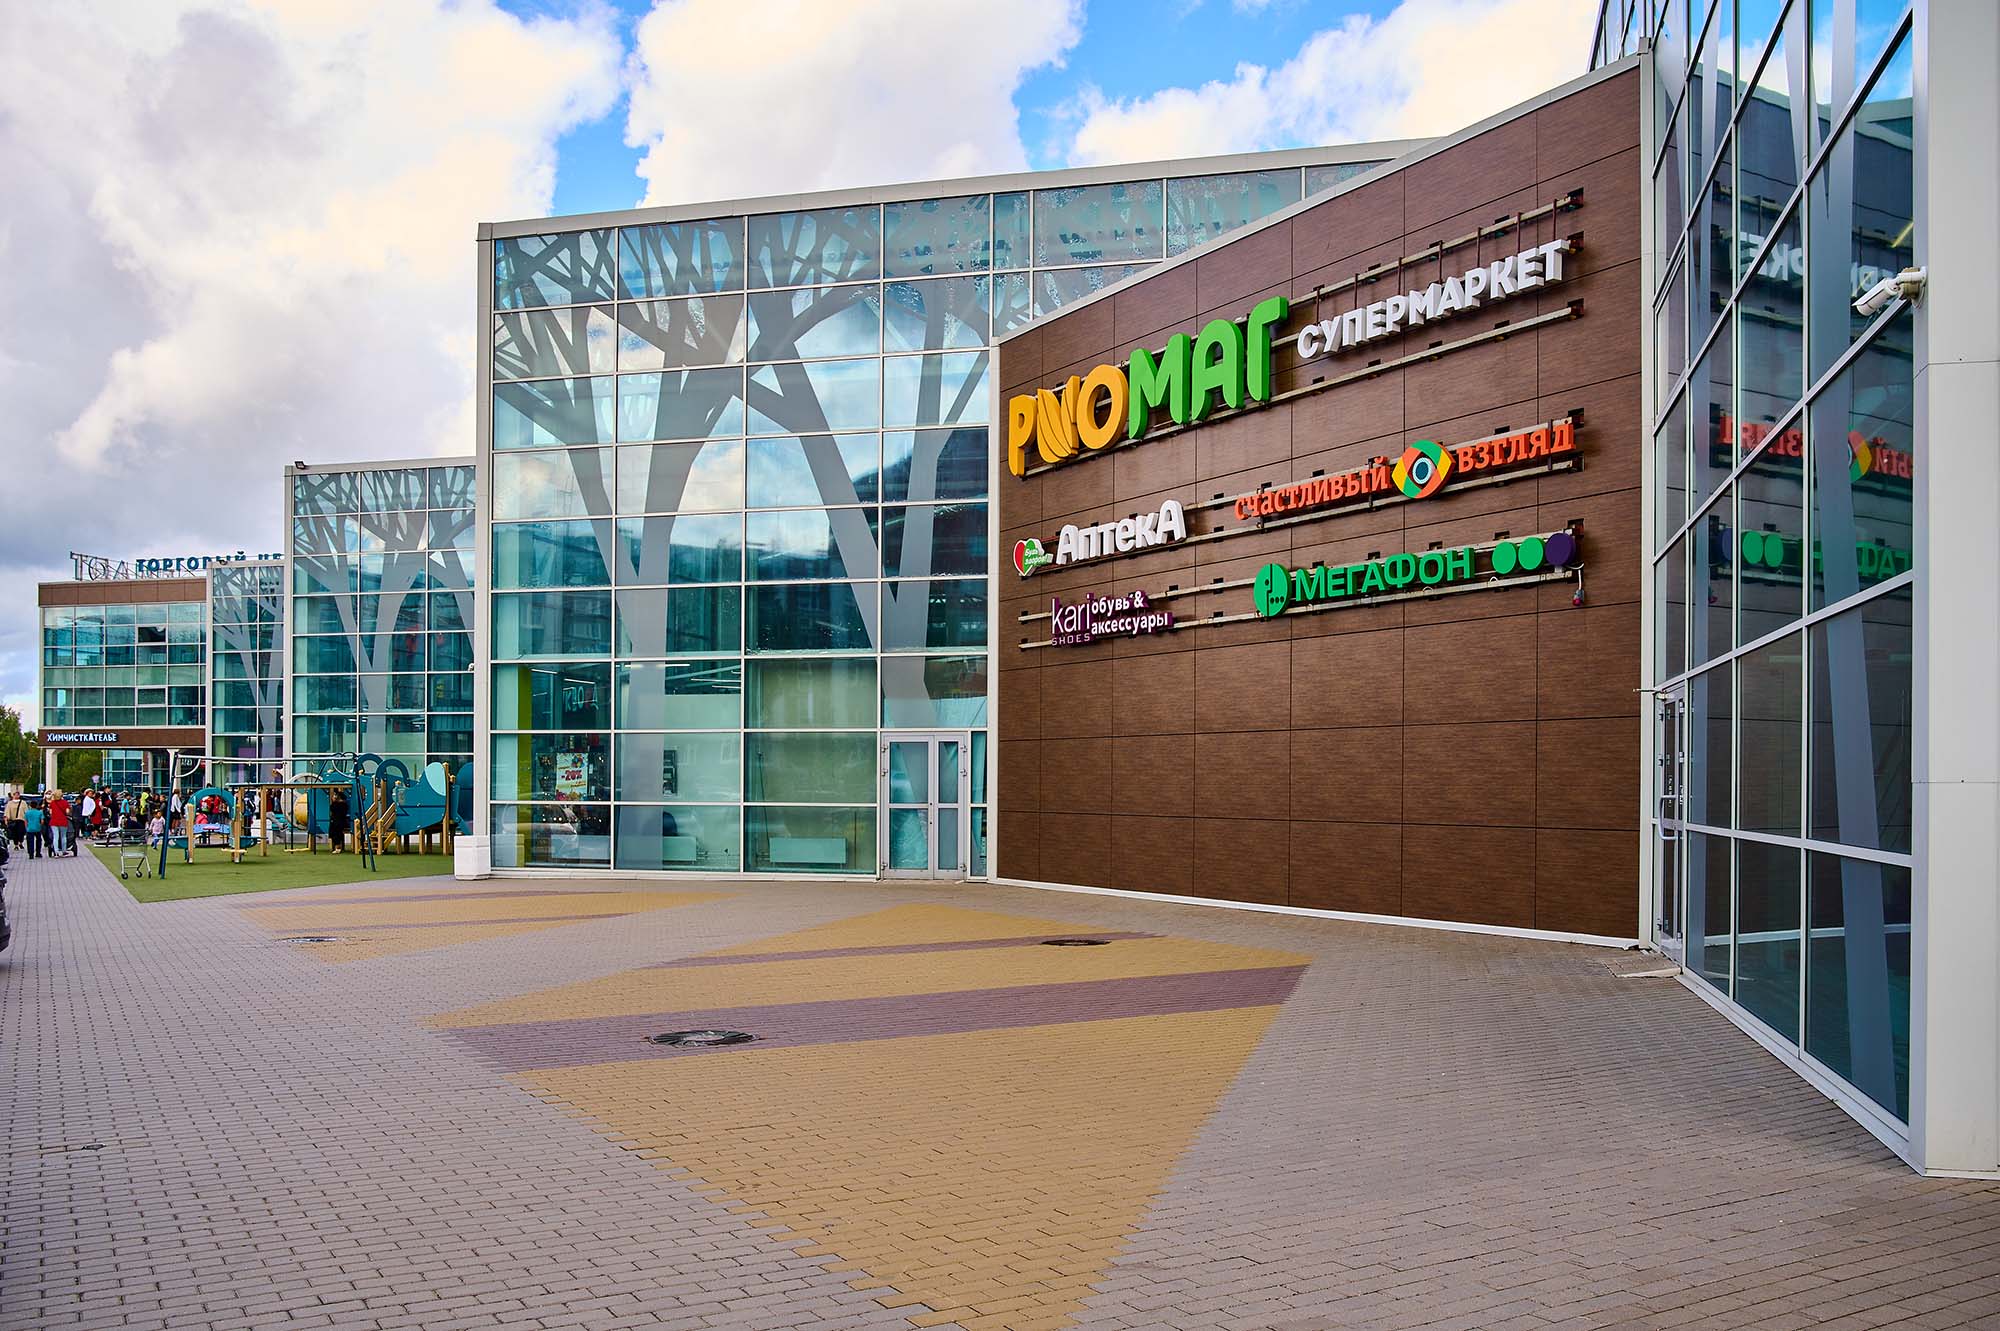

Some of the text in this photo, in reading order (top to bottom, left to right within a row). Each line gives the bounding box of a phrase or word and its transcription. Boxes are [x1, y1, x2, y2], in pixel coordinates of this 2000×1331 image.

[1297, 239, 1570, 359] СУПЕРМАРКЕТ
[1295, 546, 1475, 602] МЕГАФОН
[1052, 593, 1090, 635] kari
[1091, 596, 1131, 617] обувь
[1051, 632, 1091, 646] SHOES
[1091, 612, 1169, 635] аксессуары
